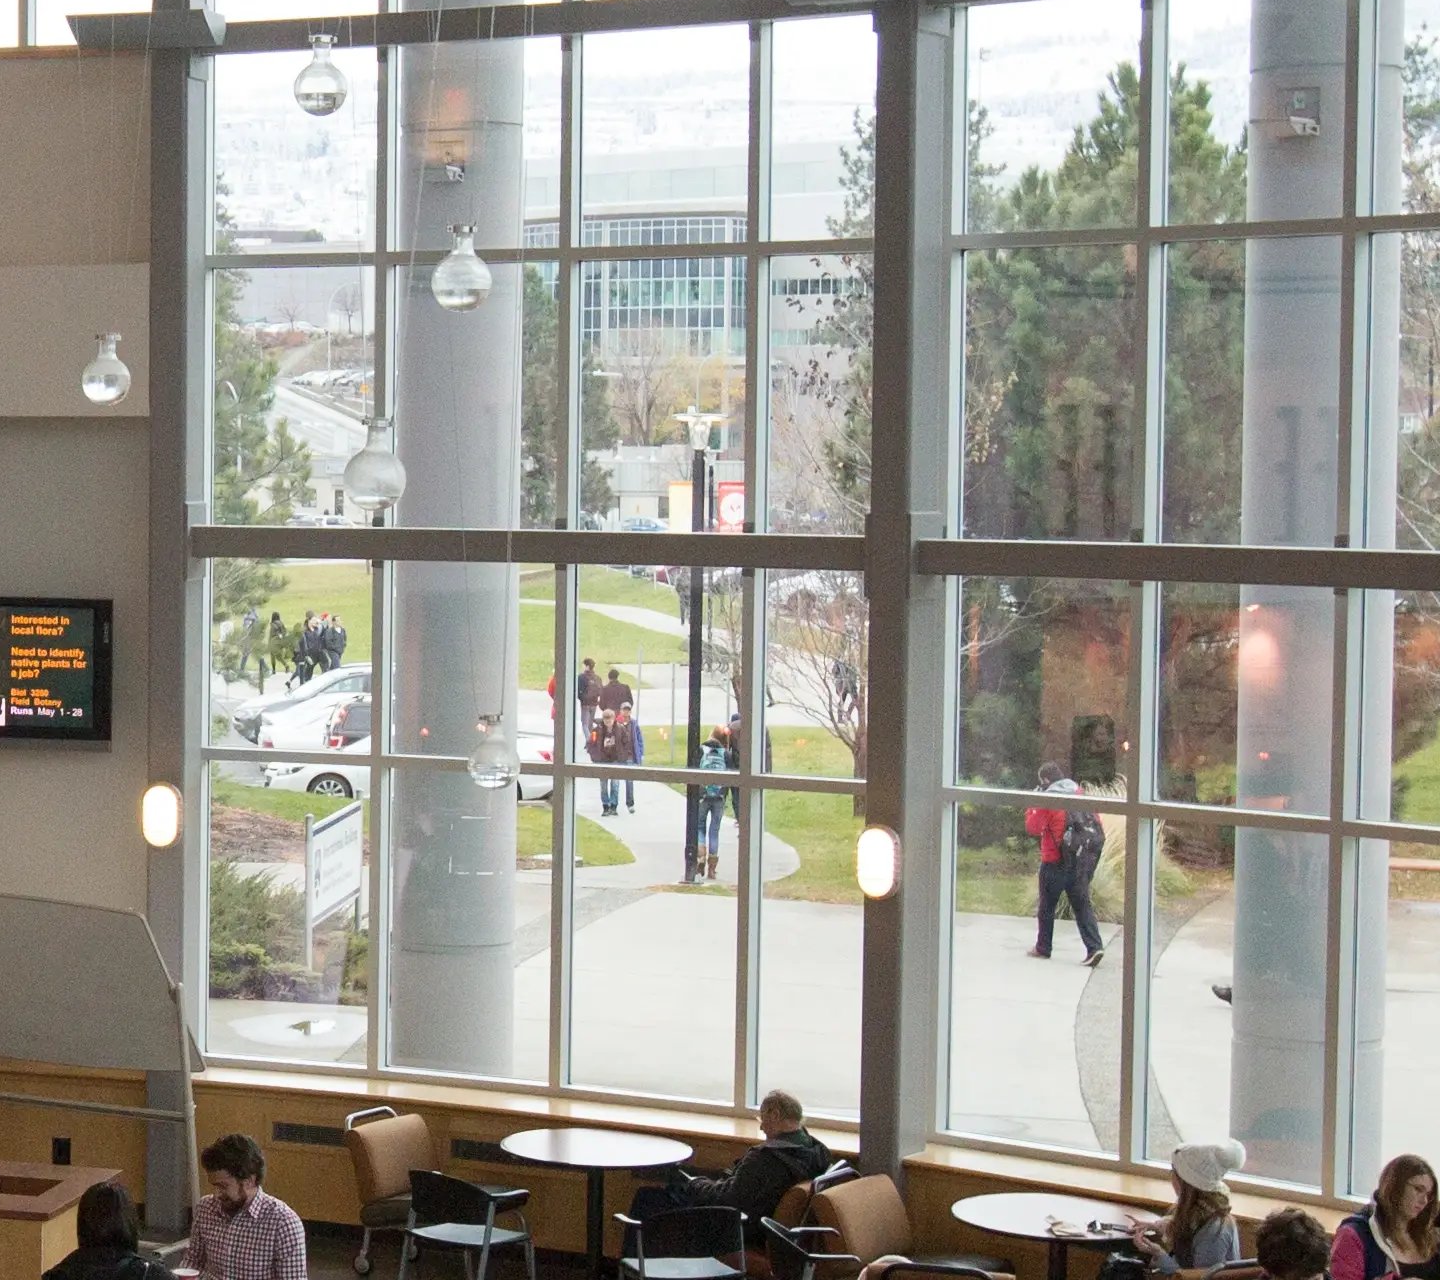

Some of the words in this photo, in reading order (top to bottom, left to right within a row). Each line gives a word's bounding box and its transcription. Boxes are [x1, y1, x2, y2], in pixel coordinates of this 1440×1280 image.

[11, 614, 59, 625] Interested
[60, 615, 70, 625] in
[11, 625, 34, 635] local
[36, 625, 64, 636] flora?
[10, 646, 36, 657] Need
[37, 647, 48, 657] to
[49, 648, 85, 659] identify
[10, 658, 40, 668] native
[41, 659, 71, 670] plants
[73, 659, 87, 669] for
[18, 668, 40, 680] job?
[10, 696, 30, 706] Field
[34, 697, 62, 708] Botany
[10, 705, 34, 716] Runs
[37, 706, 56, 718] May
